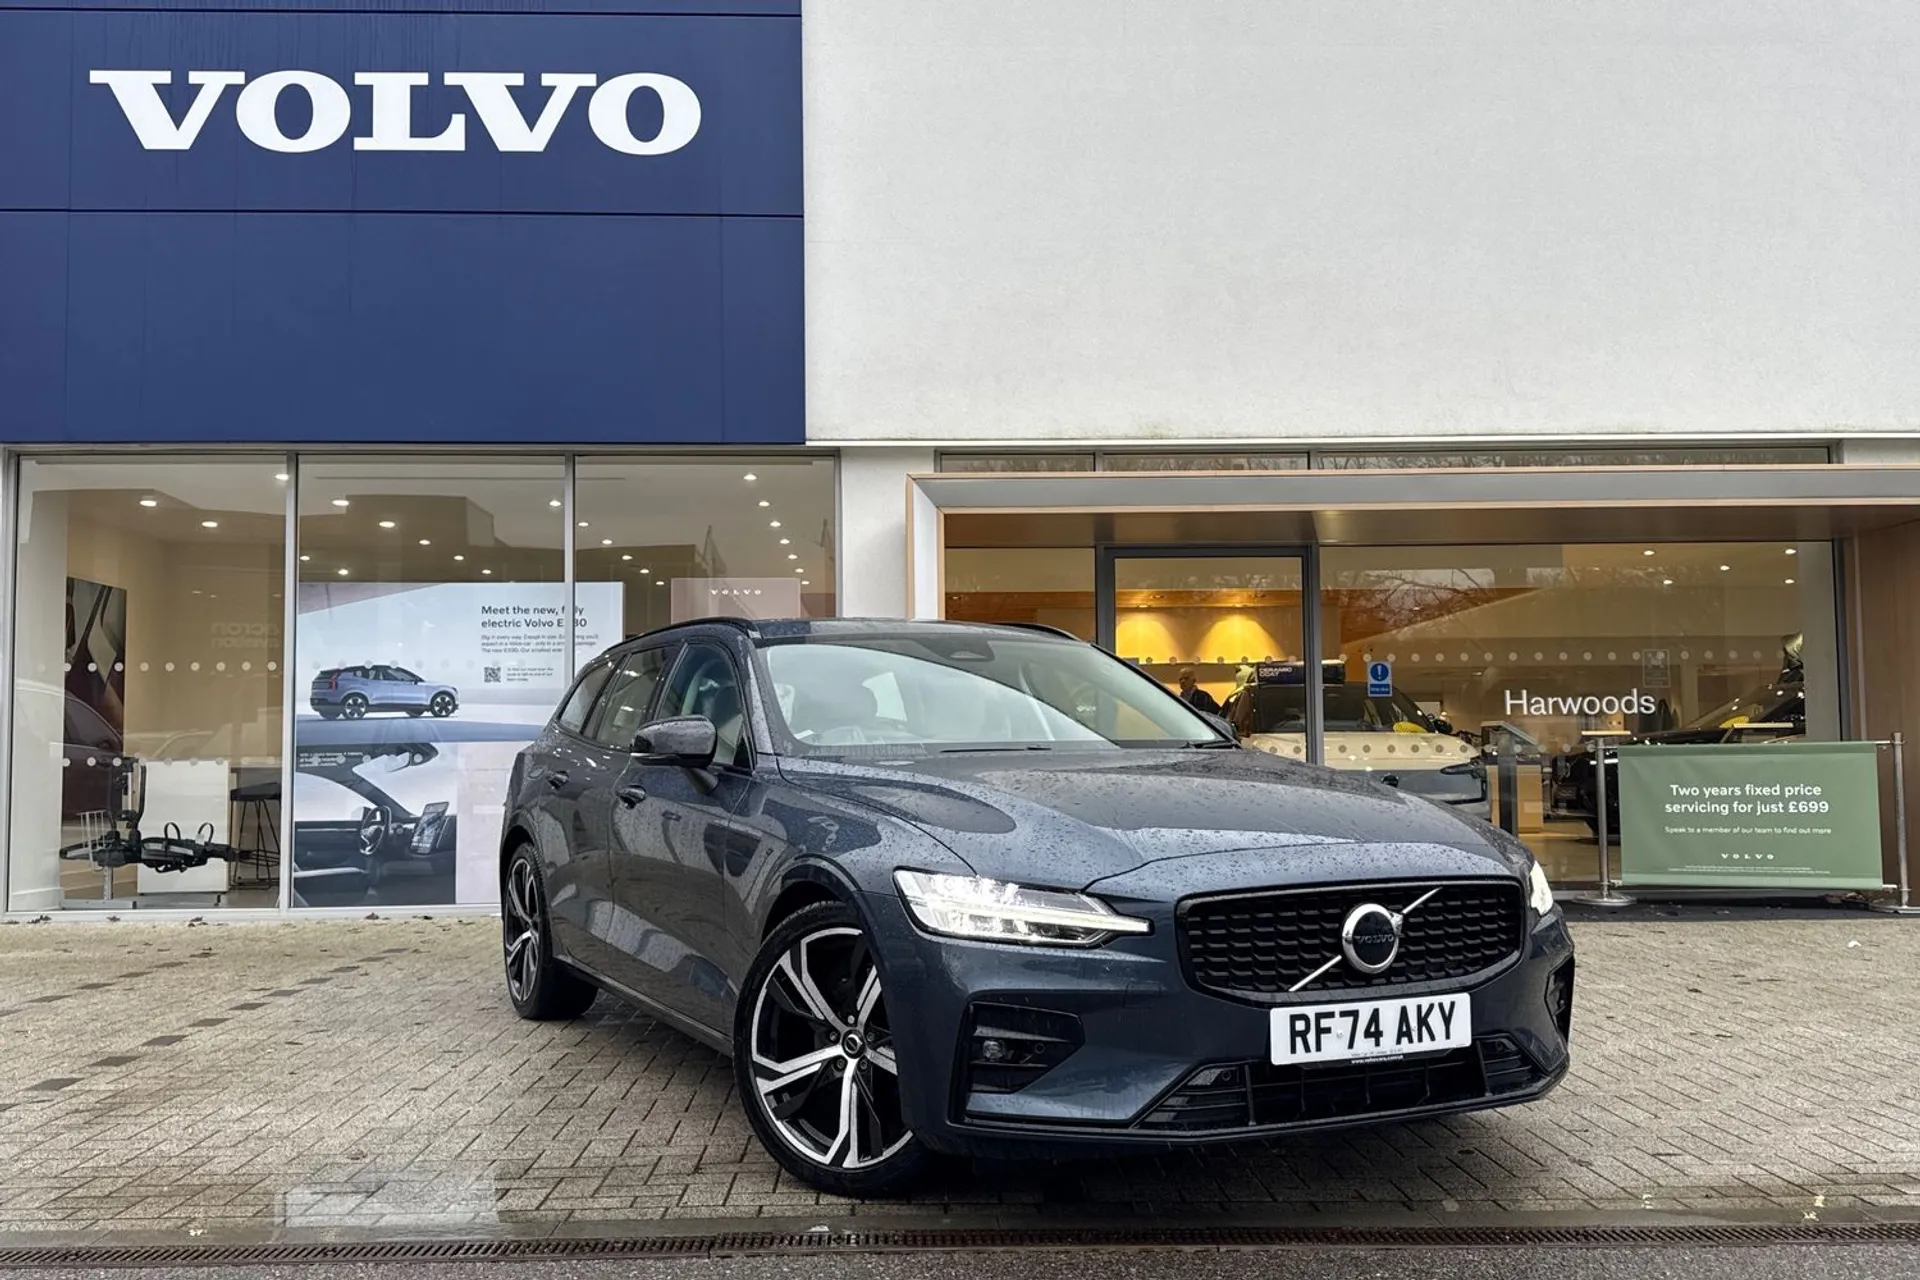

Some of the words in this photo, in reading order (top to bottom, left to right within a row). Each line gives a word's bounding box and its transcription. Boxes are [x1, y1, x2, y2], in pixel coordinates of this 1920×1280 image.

[89, 70, 701, 156] VOLVO
[481, 605, 510, 615] Meet
[512, 605, 531, 615] the
[533, 607, 558, 616] new,
[481, 618, 521, 628] electric
[524, 618, 554, 628] Volvo
[557, 618, 588, 628] E30
[1504, 688, 1656, 716] Harwoods
[1669, 784, 1700, 796] Two
[1703, 786, 1742, 799] years
[1745, 784, 1781, 796] fixed
[1785, 784, 1822, 798] price
[1664, 801, 1730, 816] servicing
[1733, 801, 1753, 813] for
[1756, 801, 1785, 816] just
[1788, 801, 1829, 813] £699
[1665, 826, 1687, 835] Speak
[1702, 826, 1732, 834] member
[1732, 826, 1740, 834] of
[1782, 826, 1797, 834] find
[1353, 933, 1394, 944] VOLVO
[1289, 1007, 1383, 1055] RF74
[1395, 1000, 1456, 1046] AKY
